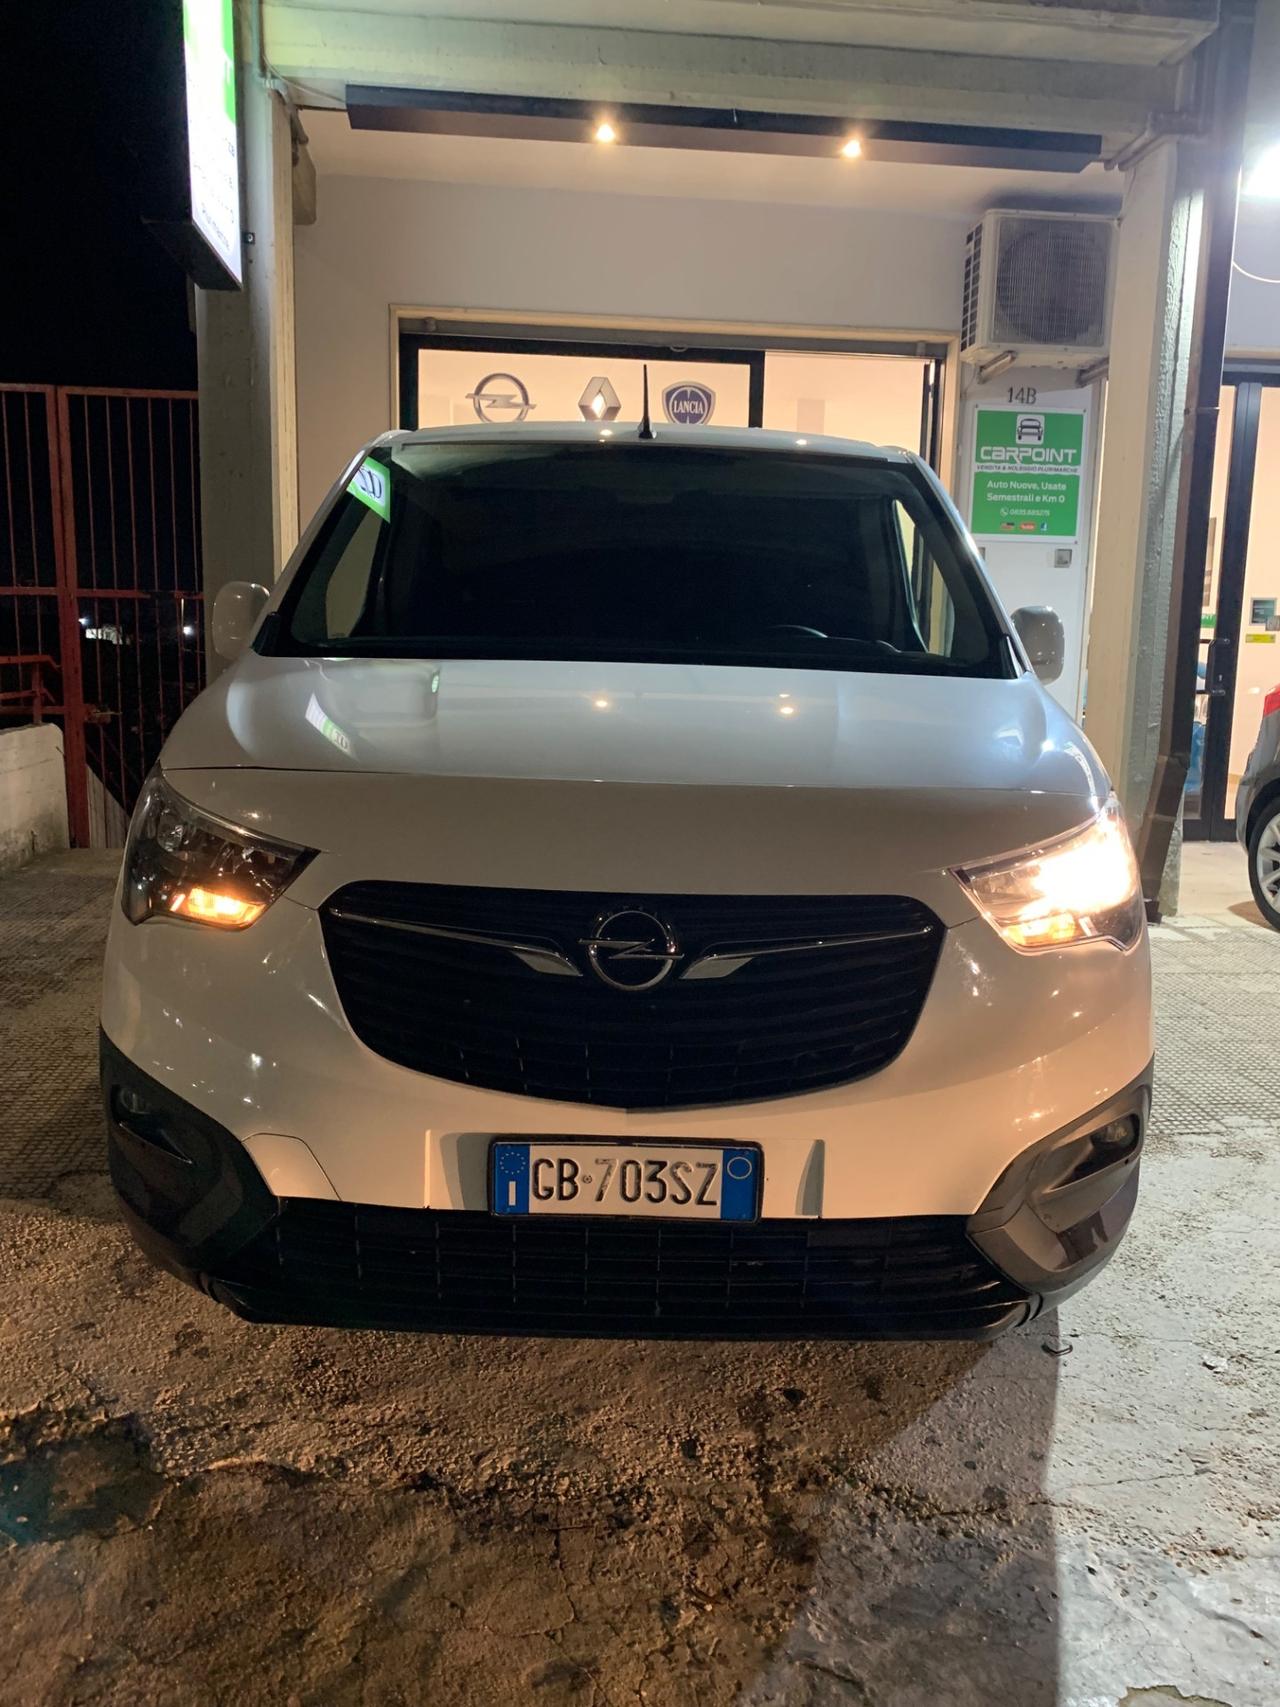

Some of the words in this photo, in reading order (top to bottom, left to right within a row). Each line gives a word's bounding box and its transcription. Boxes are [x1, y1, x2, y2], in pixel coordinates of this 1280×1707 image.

[1007, 387, 1037, 405] 14B
[673, 400, 704, 414] LANCIA
[987, 480, 1009, 489] Auto
[1041, 481, 1067, 491] Usate
[987, 492, 1034, 503] Semestrali
[1042, 495, 1057, 503] Km
[532, 1157, 580, 1201] GB
[595, 1158, 720, 1206] 703SZ
